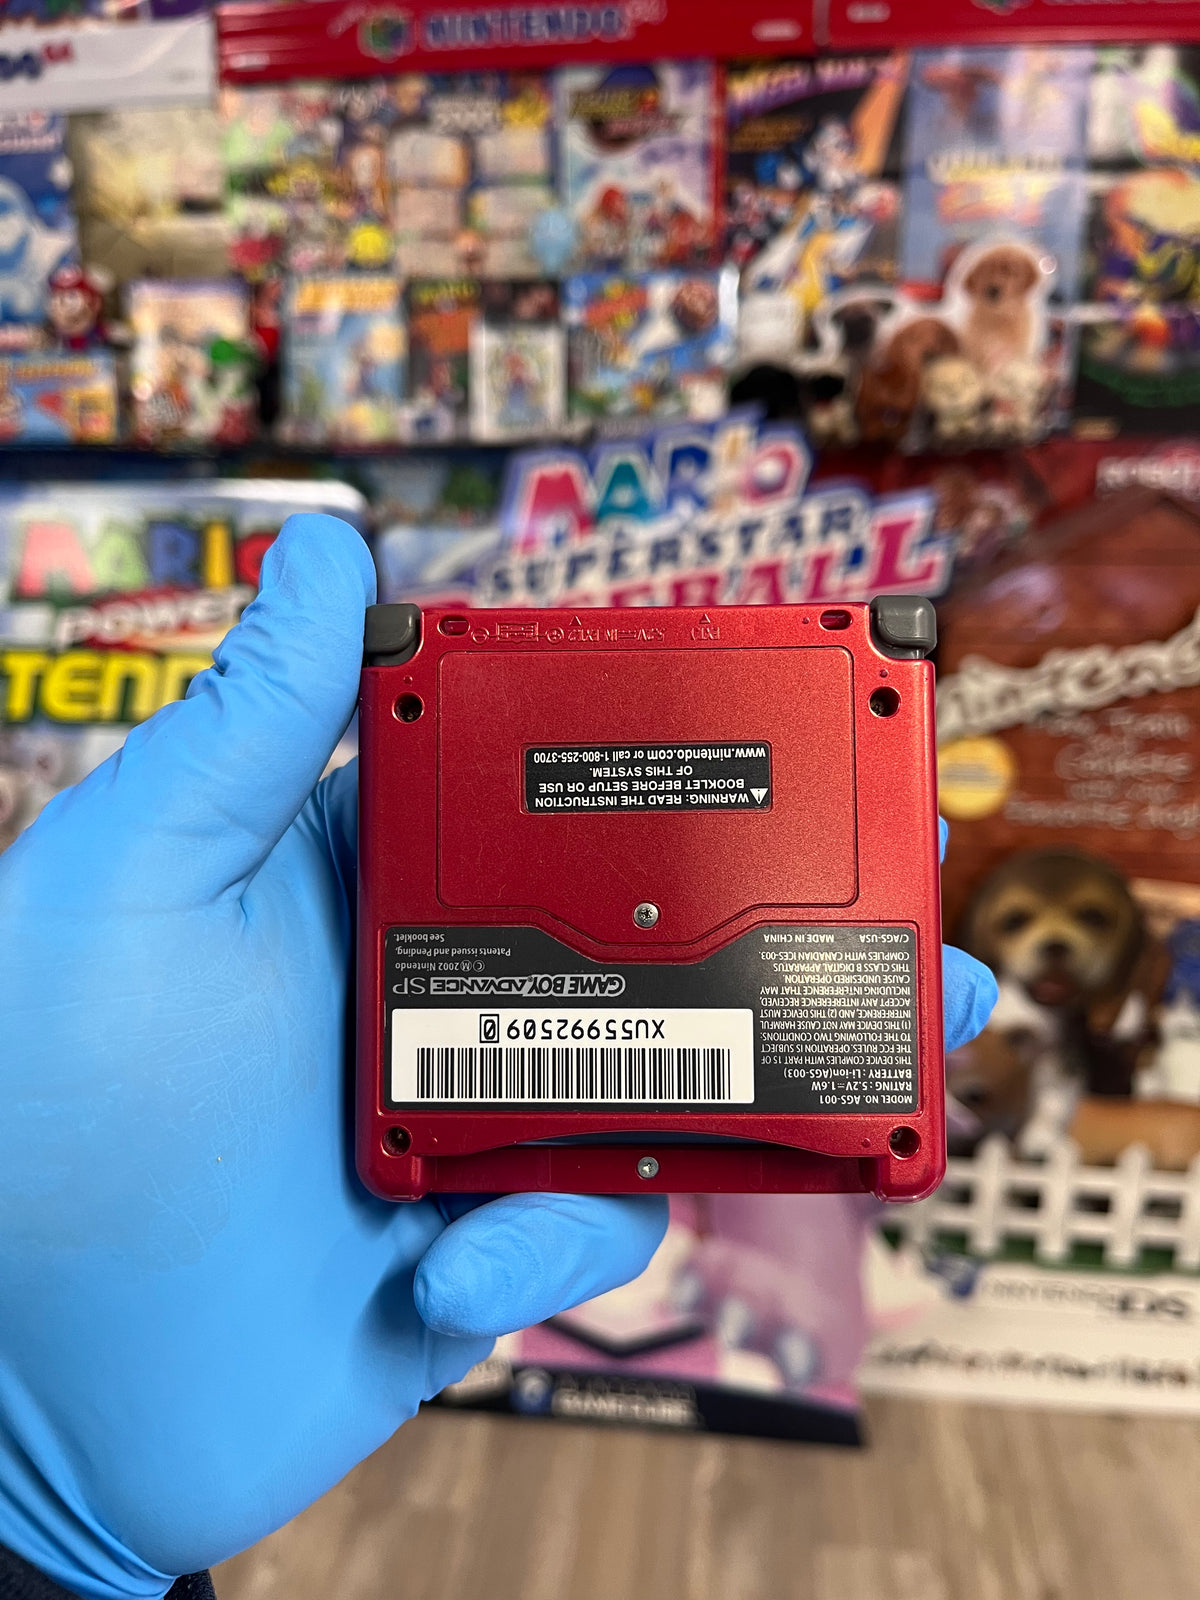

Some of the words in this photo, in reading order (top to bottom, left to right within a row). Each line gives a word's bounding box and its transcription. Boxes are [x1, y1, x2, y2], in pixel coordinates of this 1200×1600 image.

[490, 502, 856, 596] SUPERSTAR
[534, 752, 610, 763] 1-800-255-3700
[612, 751, 630, 762] call
[634, 751, 644, 759] or
[647, 748, 765, 761] www.nintendo.com
[589, 767, 642, 777] SYSTEM.
[646, 767, 672, 776] THIS
[676, 766, 692, 775] OF
[539, 783, 563, 792] USE
[567, 782, 584, 792] OR
[588, 781, 628, 791] SETUP
[632, 780, 681, 790] BEFORE
[685, 779, 744, 789] BOOKLET
[535, 796, 617, 807] INSTRUCTION
[620, 795, 643, 805] THE
[648, 794, 682, 804] READ
[686, 793, 749, 803] WARNING:
[394, 933, 428, 942] booklet.
[430, 933, 445, 942] See
[764, 934, 792, 942] CHINA
[795, 934, 805, 942] IN
[807, 934, 834, 942] MADE
[859, 934, 909, 942] C/AGS-USA
[434, 948, 449, 956] and
[452, 948, 477, 956] issued
[480, 948, 511, 956] Patents
[759, 952, 796, 960] ICES-003.
[798, 952, 843, 960] CANADIAN
[845, 952, 866, 960] WITH
[868, 952, 909, 960] COMPLIES
[395, 962, 436, 971] Nintendo
[773, 963, 821, 972] APPARATUS
[823, 963, 854, 972] DIGITAL
[856, 963, 862, 972] B
[864, 963, 889, 972] CLASS
[891, 963, 910, 972] THIS
[783, 975, 832, 983] OPERATION.
[834, 975, 881, 983] UNDESIRED
[883, 975, 910, 983] CAUSE
[393, 978, 426, 994] SP
[432, 979, 527, 992] ADVANCE
[570, 976, 623, 995] GAME
[760, 986, 778, 994] MAY
[781, 986, 801, 994] THAT
[803, 986, 862, 994] INTERFERENCE
[864, 986, 910, 994] INCLUDING
[760, 998, 800, 1006] RECEIVED,
[801, 998, 859, 1006] INTERFERENCE
[861, 998, 878, 1006] ANY
[880, 998, 910, 1006] ACCEPT
[760, 1009, 781, 1018] MUST
[783, 1009, 808, 1018] DEVICE
[810, 1009, 826, 1018] THIS
[827, 1009, 837, 1018] (2)
[839, 1009, 855, 1018] AND
[856, 1009, 910, 1018] INTERFERENCE,
[507, 1019, 665, 1040] XU55992509
[760, 1021, 795, 1030] HARMFUL
[797, 1021, 821, 1030] CAUSE
[822, 1021, 838, 1030] NOT
[839, 1021, 855, 1030] MAY
[857, 1021, 882, 1030] DEVICE
[884, 1021, 900, 1030] THIS
[902, 1021, 911, 1030] (1)
[760, 1032, 812, 1041] CONDITIONS:
[814, 1032, 833, 1041] TWO
[835, 1032, 882, 1041] FOLLOWING
[884, 1032, 899, 1041] THE
[901, 1032, 911, 1041] TO
[761, 1044, 794, 1052] SUBJECT
[796, 1044, 803, 1052] IS
[805, 1044, 850, 1052] OPERATION
[851, 1044, 878, 1052] RULES.
[880, 1044, 894, 1052] FCC
[896, 1044, 911, 1052] THE
[761, 1056, 771, 1064] OF
[773, 1056, 781, 1064] 15
[785, 1056, 802, 1064] PART
[804, 1056, 825, 1064] WITH
[826, 1056, 864, 1064] COMPLIES
[866, 1056, 893, 1064] DEVICE
[895, 1056, 911, 1064] THIS
[784, 1068, 861, 1078] Li-ion(AGS-003)
[868, 1069, 912, 1078] BATTERY
[875, 1082, 912, 1090] RATING
[819, 1095, 860, 1104] AGS-001
[863, 1095, 878, 1103] NO.
[881, 1095, 912, 1103] MODEL
